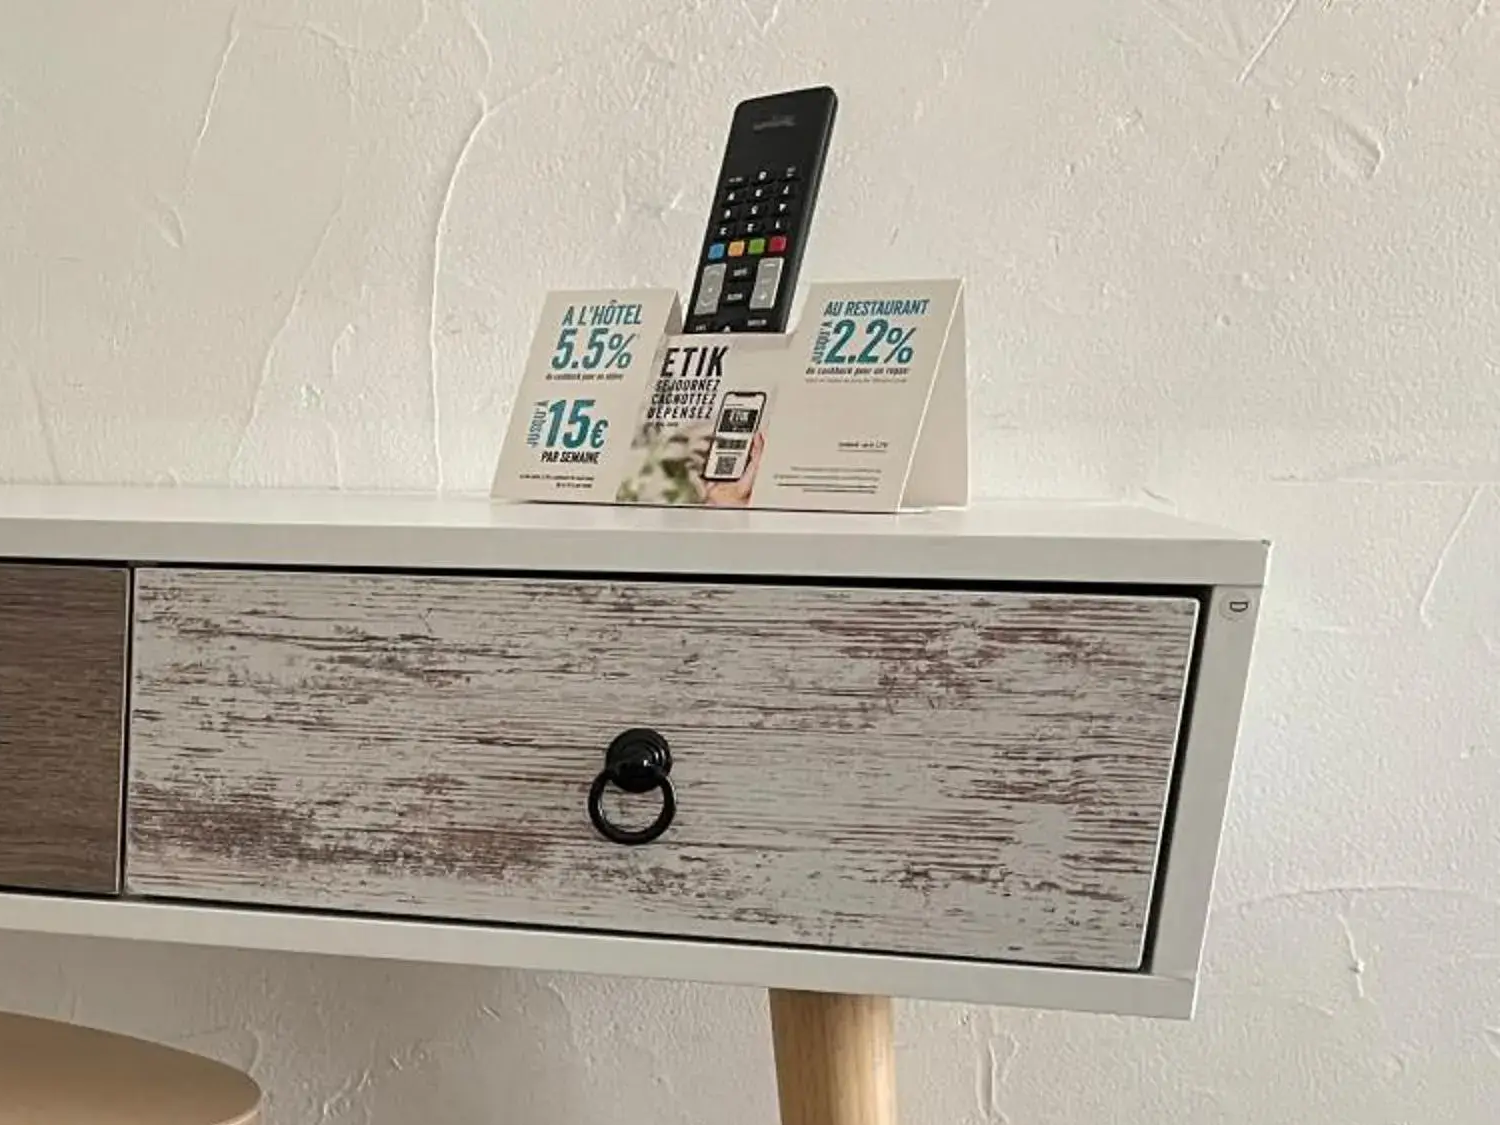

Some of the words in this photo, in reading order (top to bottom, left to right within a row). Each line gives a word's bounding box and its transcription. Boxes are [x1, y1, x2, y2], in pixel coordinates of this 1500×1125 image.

[578, 299, 643, 325] L'HÔTEL
[824, 301, 842, 316] AU
[844, 299, 930, 316] RESTAURANT
[552, 328, 636, 370] 5.5%
[824, 319, 917, 364] 2.2%
[660, 346, 729, 377] ETIK
[546, 400, 609, 449] 15€
[540, 451, 558, 464] PAR
[560, 451, 601, 464] SEMAINE
